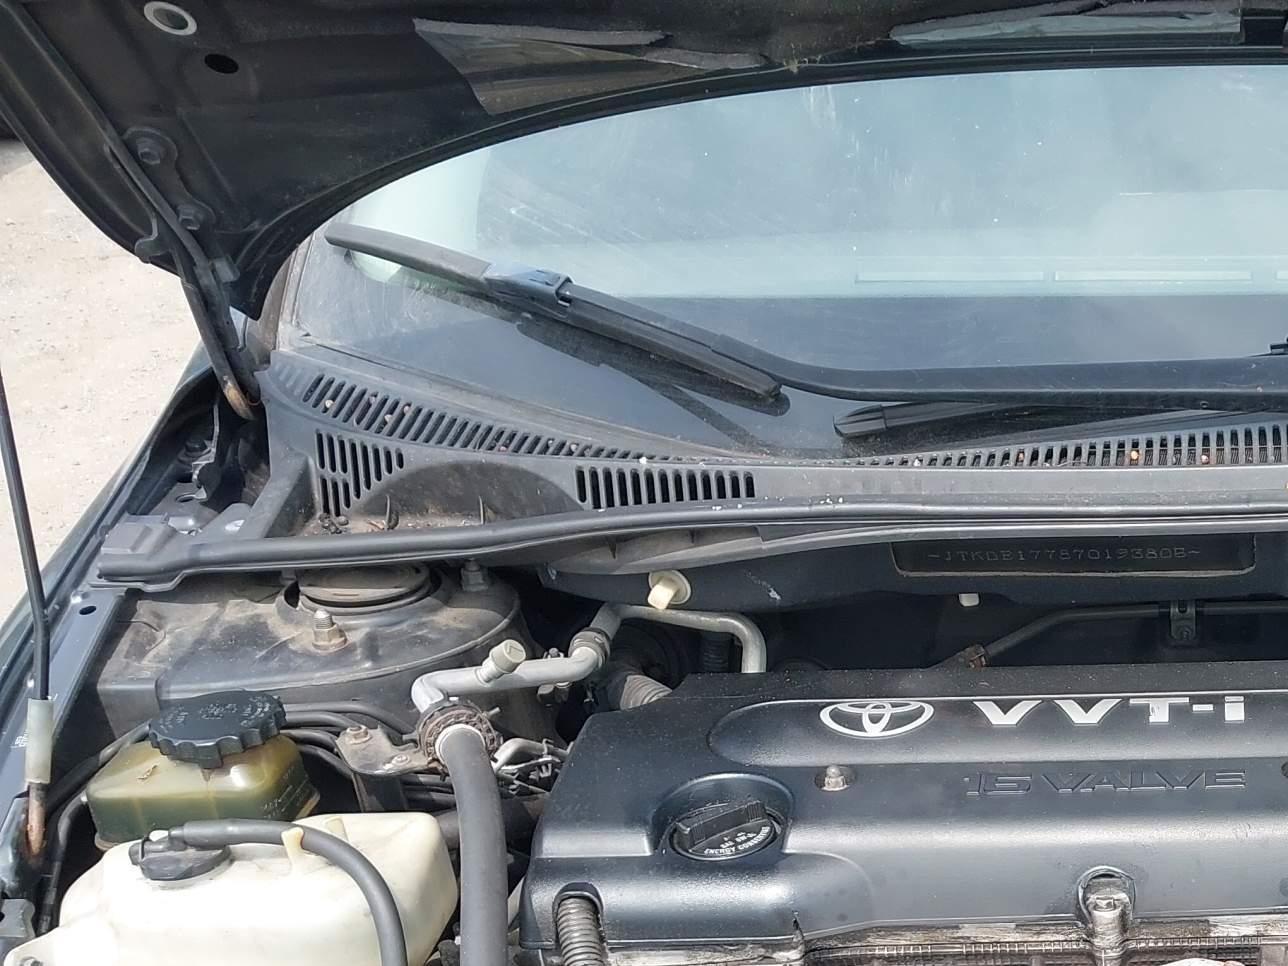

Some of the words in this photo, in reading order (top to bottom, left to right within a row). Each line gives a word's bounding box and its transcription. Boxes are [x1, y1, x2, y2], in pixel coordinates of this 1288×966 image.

[972, 695, 1245, 726] VVT-i
[1040, 769, 1247, 794] VALVE
[704, 846, 736, 856] ENERGY
